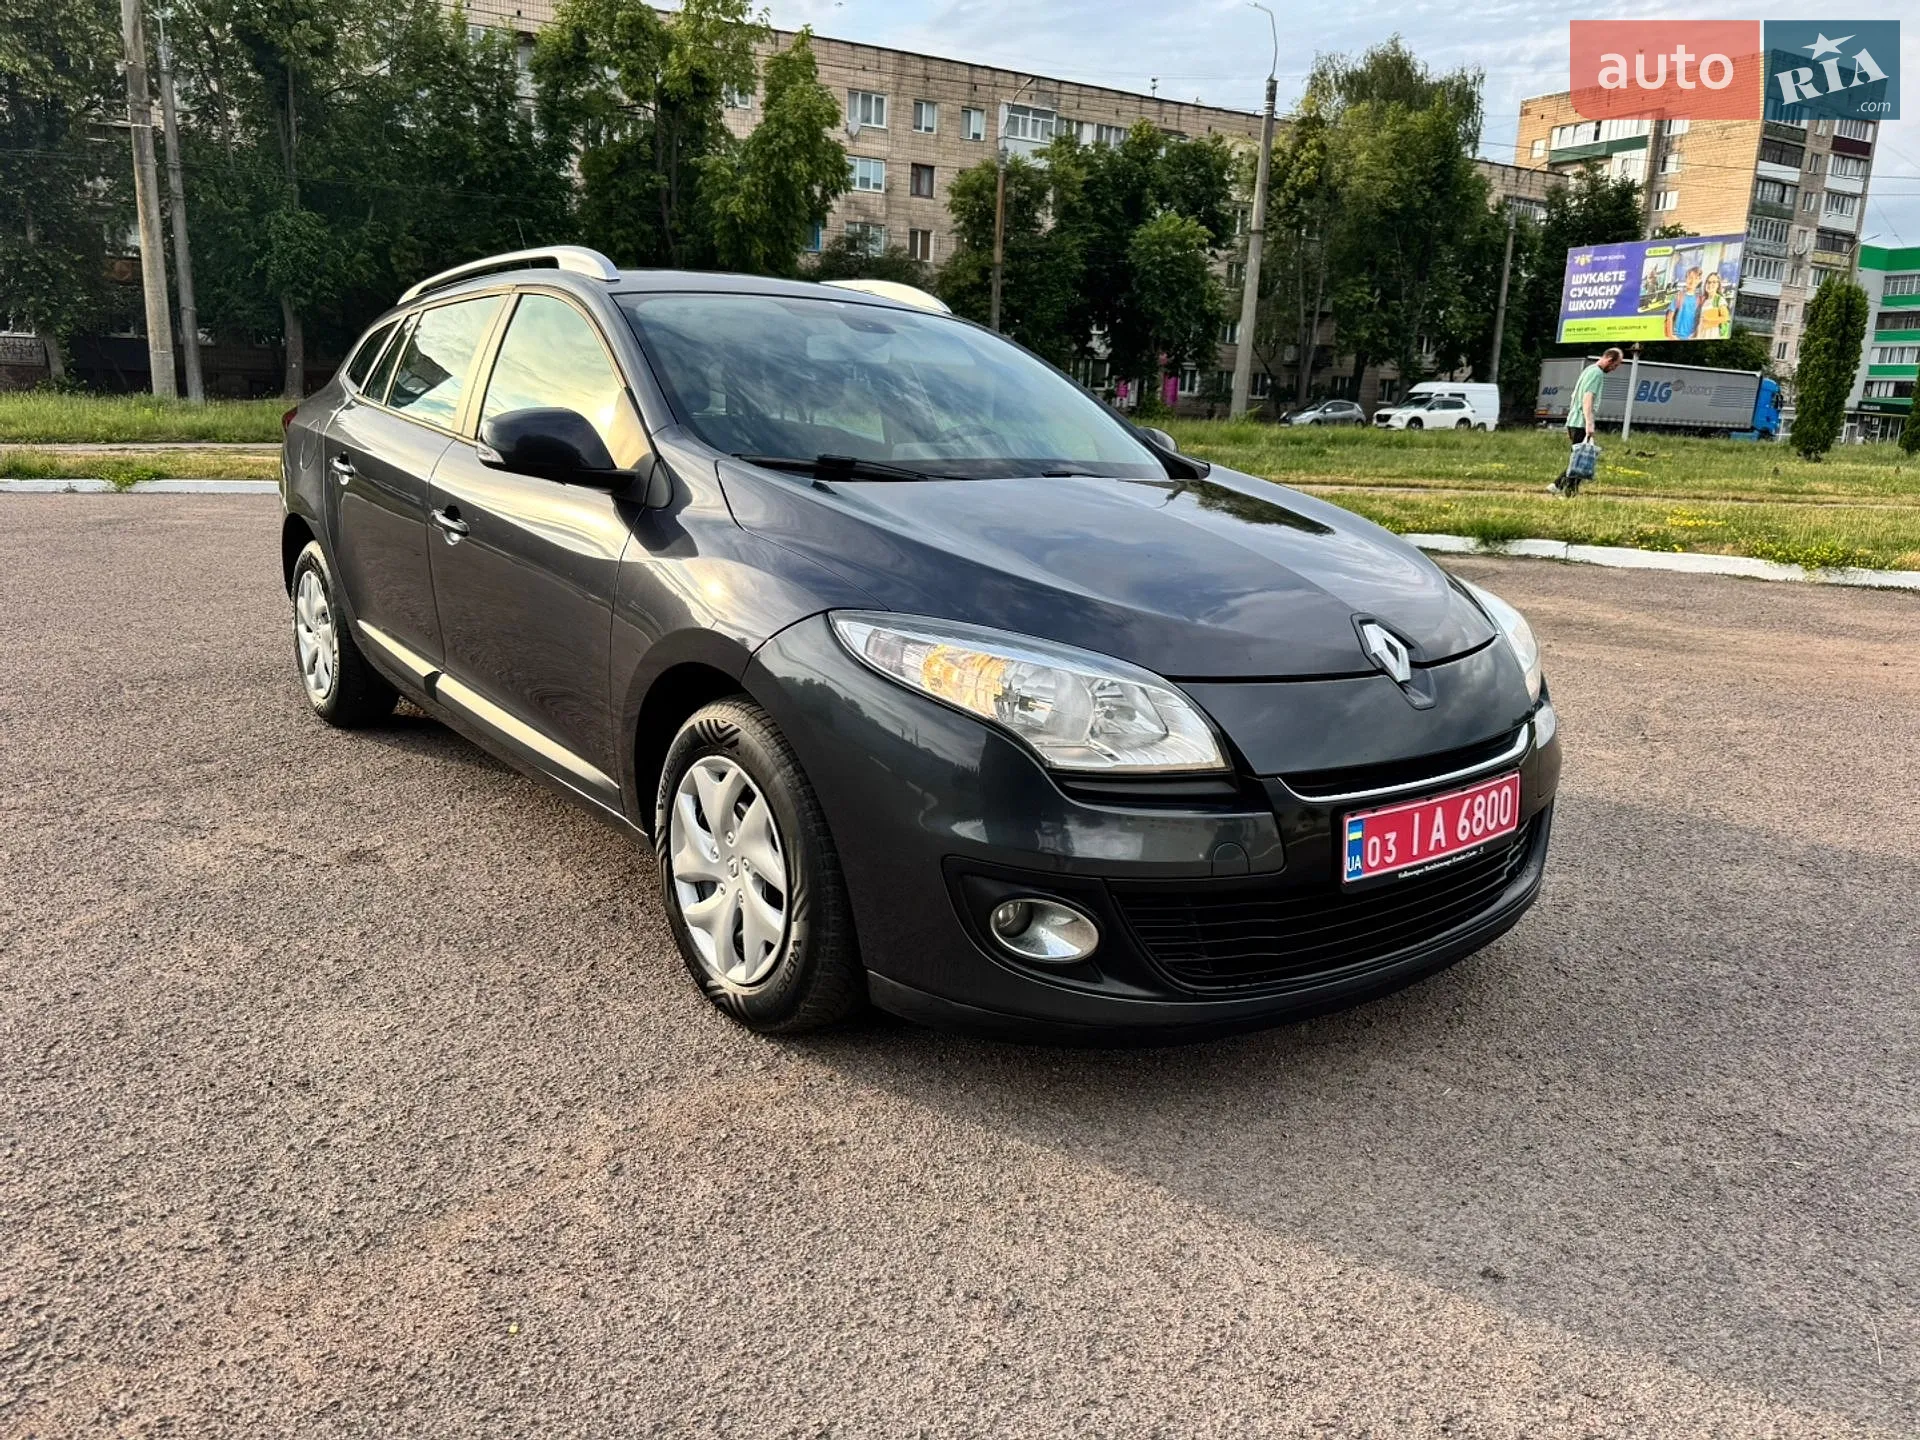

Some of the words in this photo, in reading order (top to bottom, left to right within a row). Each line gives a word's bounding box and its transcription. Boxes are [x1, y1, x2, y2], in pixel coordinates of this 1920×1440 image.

[1571, 271, 1627, 285] ШУКАЄТЕ
[1569, 284, 1623, 298] СУЧАСНУ
[1568, 299, 1616, 312] ШКОЛУ?
[1541, 386, 1558, 396] BLG
[1634, 380, 1672, 403] BLG
[1367, 831, 1397, 868] 03
[1411, 806, 1447, 856] IA
[1456, 785, 1512, 842] 6800
[1347, 855, 1362, 871] UA
